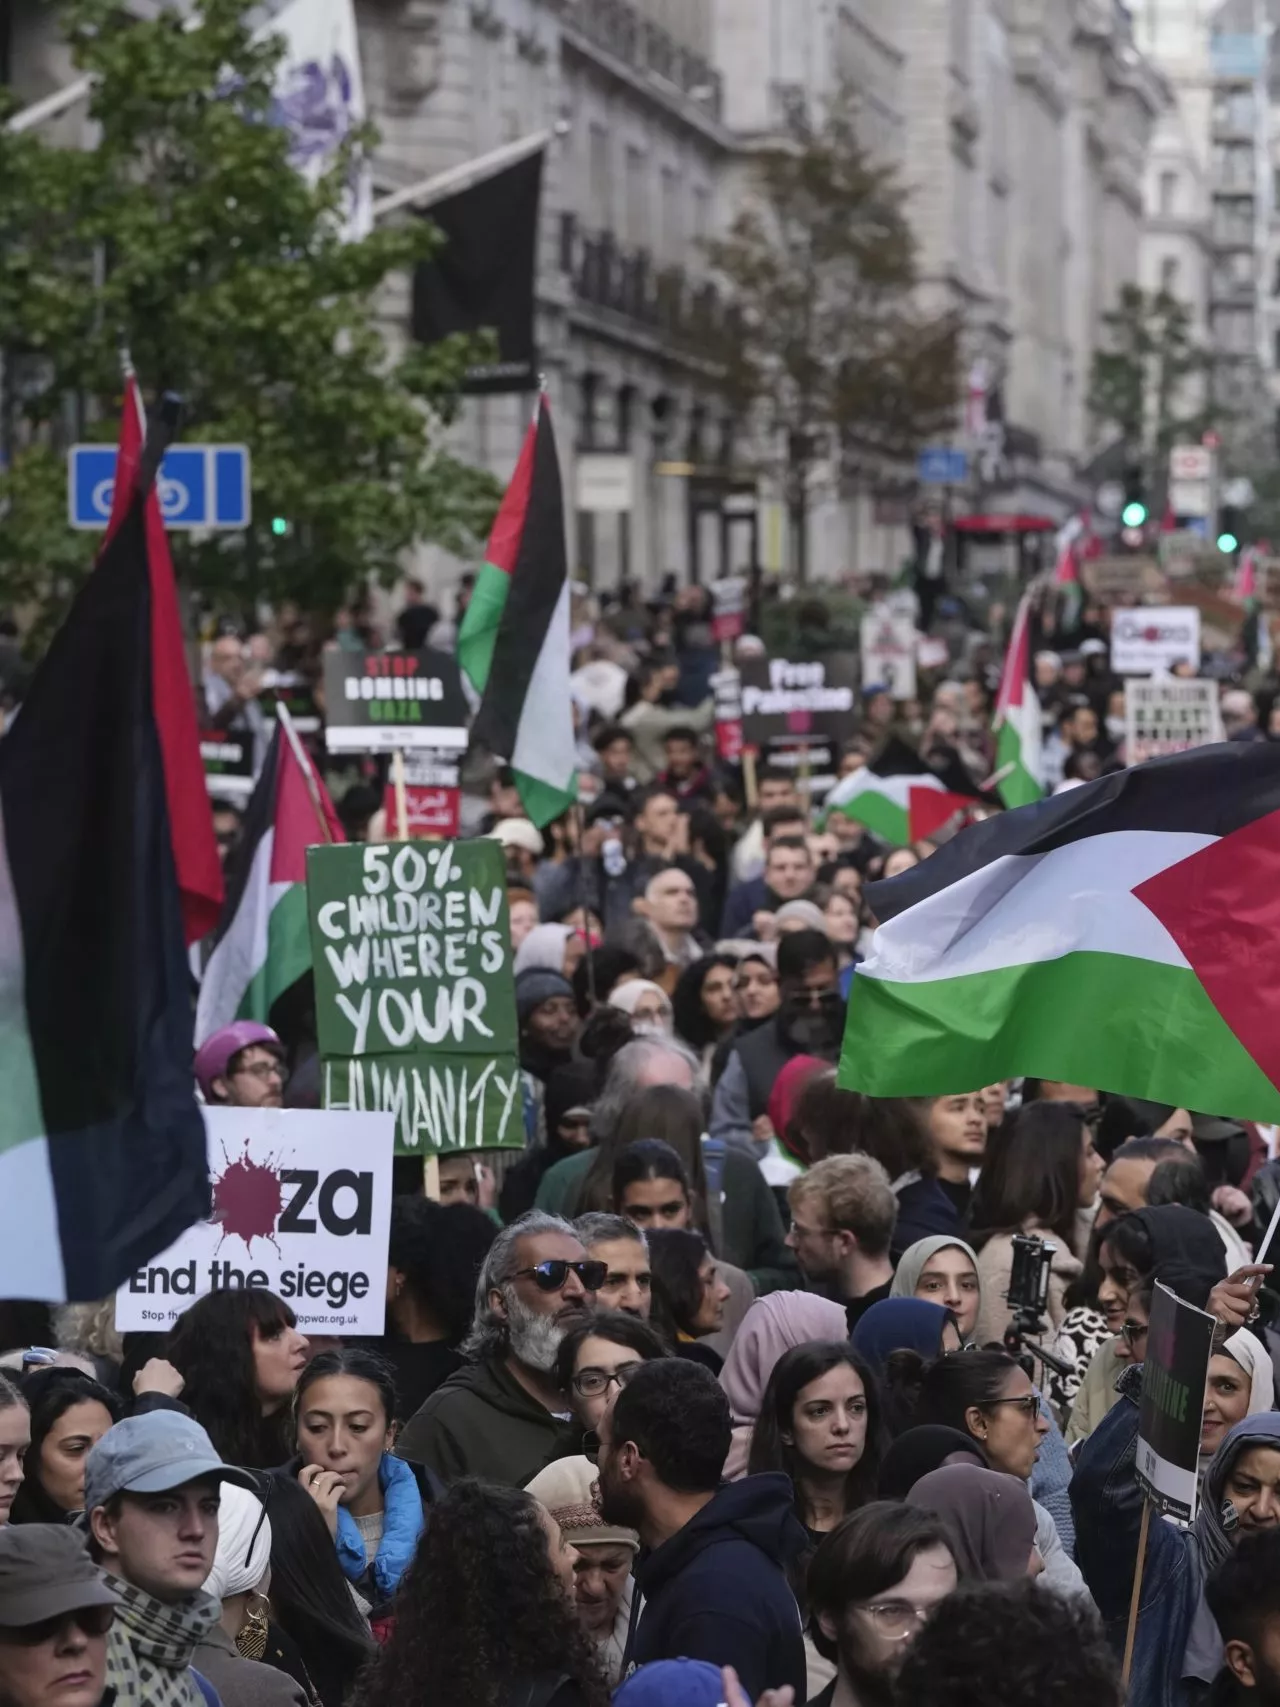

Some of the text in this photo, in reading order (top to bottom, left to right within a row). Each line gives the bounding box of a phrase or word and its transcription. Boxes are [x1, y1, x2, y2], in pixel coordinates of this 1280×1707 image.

[365, 656, 420, 677] STOP
[769, 658, 825, 688] Free
[345, 677, 444, 701] BOMBING
[741, 686, 853, 715] Palestine
[368, 700, 423, 721] GAZA
[362, 844, 462, 894] 50%
[318, 887, 502, 940] CHILDREN
[324, 929, 504, 988] WHERE'S
[334, 977, 494, 1054] YOUR
[208, 1260, 269, 1290] the
[279, 1262, 370, 1309] siege
[141, 1309, 359, 1326] Stop th topwar.org.uk
